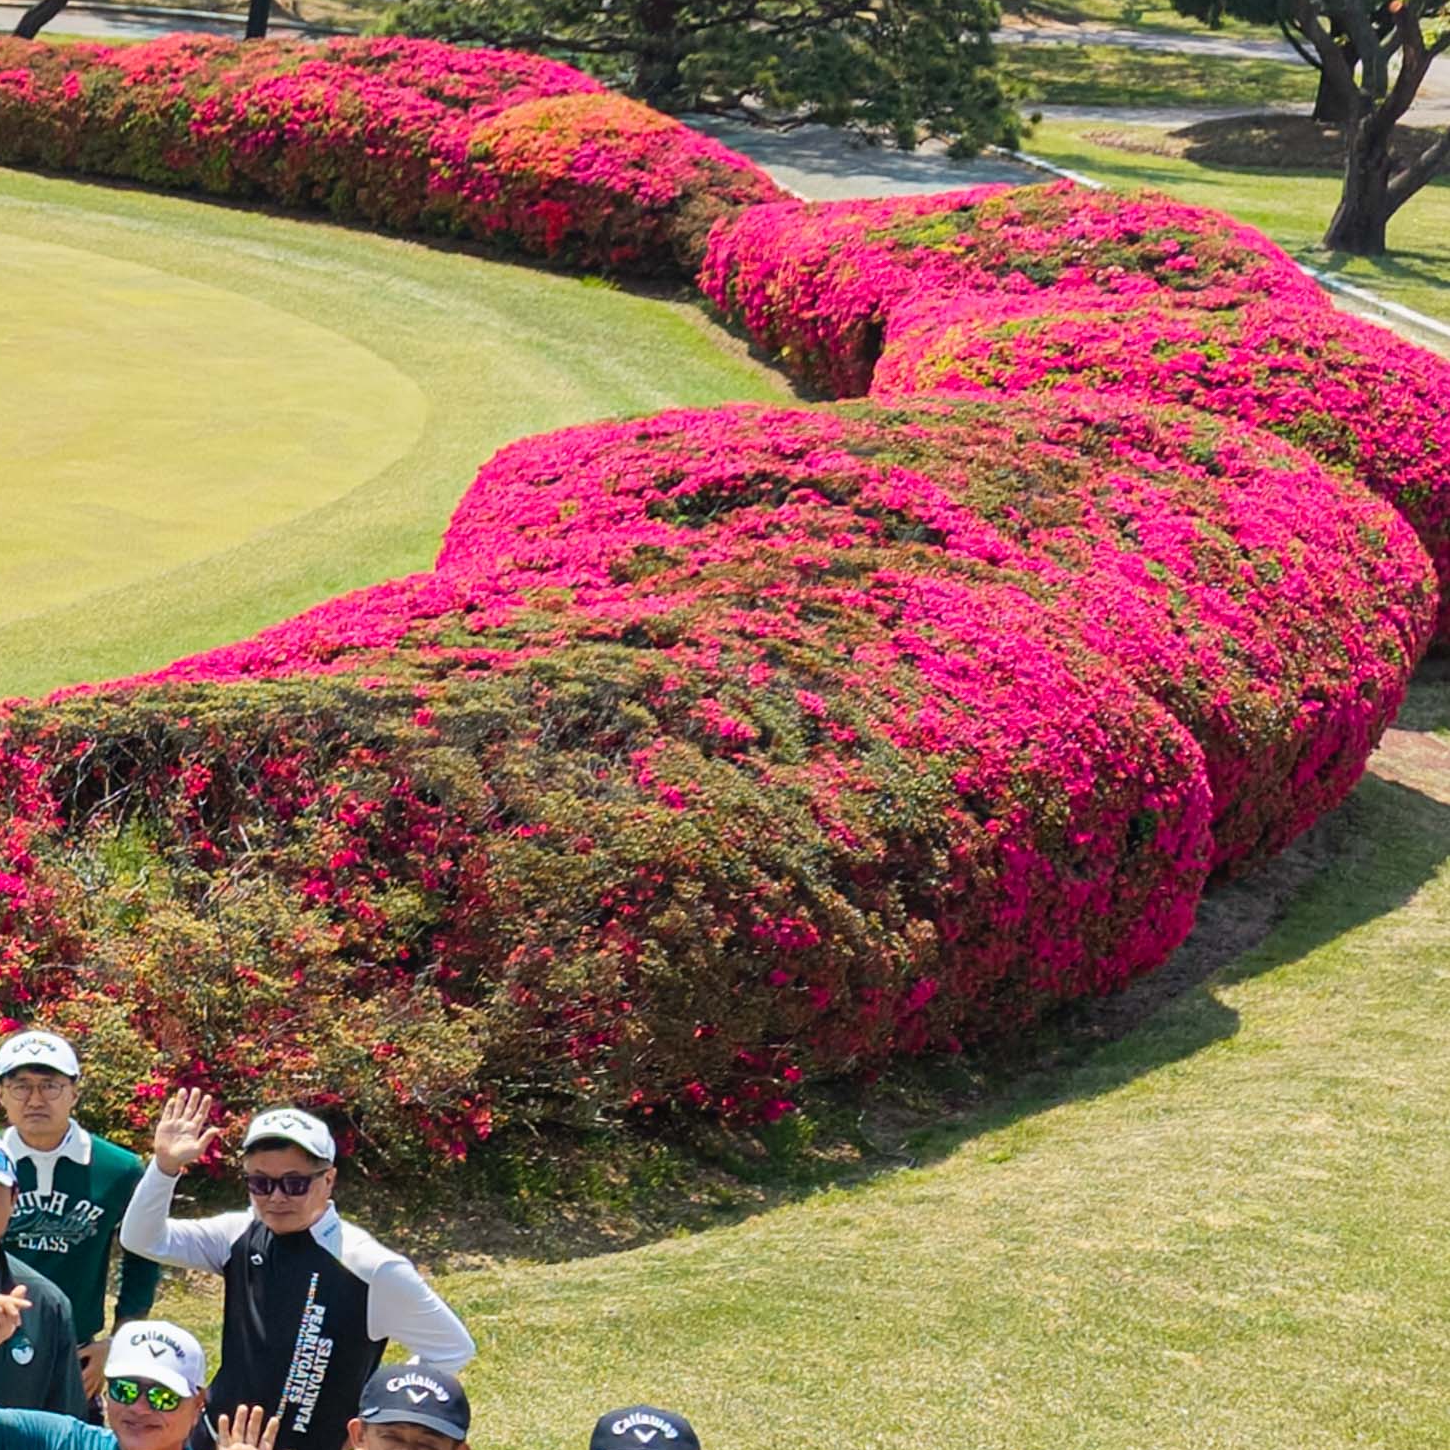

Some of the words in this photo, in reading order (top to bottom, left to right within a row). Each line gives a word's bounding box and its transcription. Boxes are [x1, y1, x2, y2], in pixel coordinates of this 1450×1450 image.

[263, 1114, 312, 1130] Callaway
[130, 1332, 185, 1358] Callaway
[292, 1338, 334, 1434] PEARLYGATES
[386, 1374, 449, 1402] Callaway
[612, 1413, 678, 1438] Callaway
